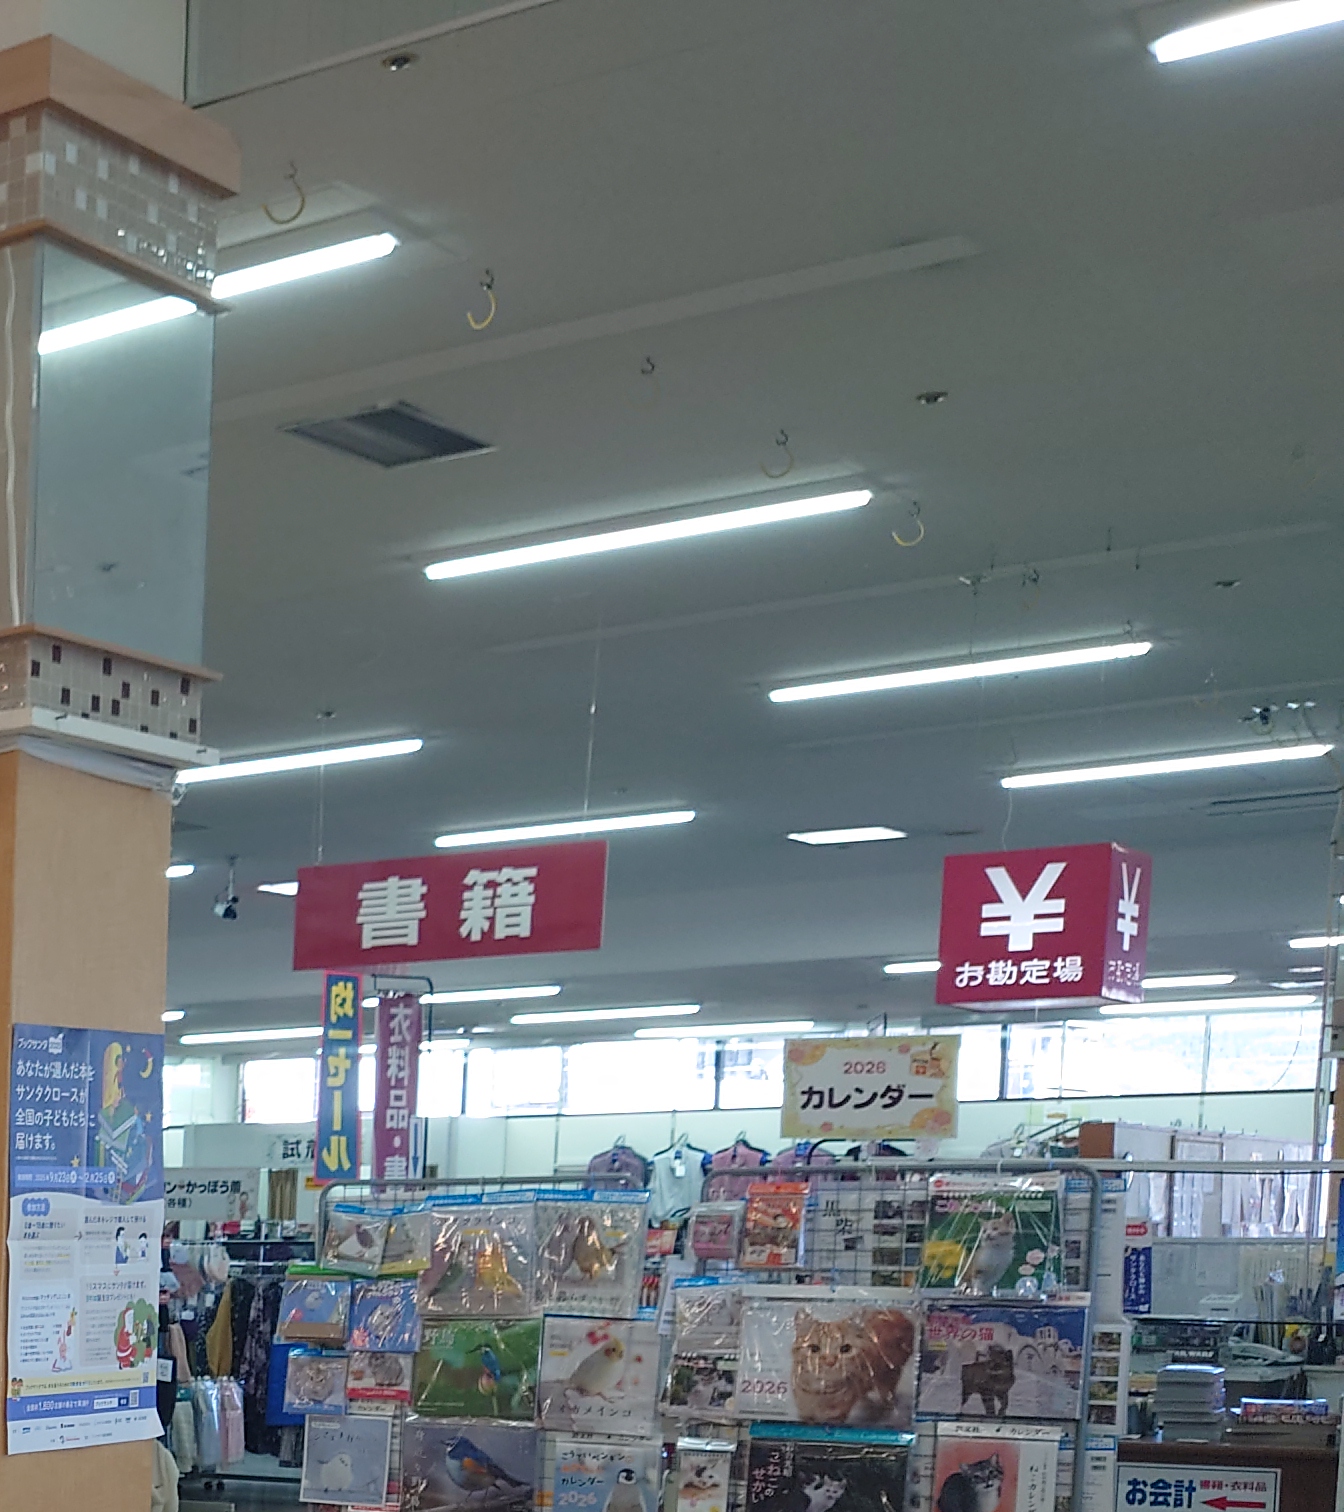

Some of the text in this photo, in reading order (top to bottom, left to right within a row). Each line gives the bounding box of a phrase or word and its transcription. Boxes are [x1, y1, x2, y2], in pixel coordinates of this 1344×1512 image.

[356, 866, 538, 949] 書籍
[980, 862, 1068, 952] ¥
[955, 955, 1084, 989] お勘定場
[17, 1038, 48, 1050] ブックサンタ
[16, 1060, 95, 1081] あなたが選んだ本を
[843, 1061, 886, 1075] 2026
[15, 1085, 87, 1103] サンタクロースが
[800, 1083, 934, 1110] カレンダー
[15, 1108, 96, 1126] 全国の子どもたちに
[15, 1132, 56, 1150] 届けます。
[927, 1325, 994, 1342] 世界の猫
[741, 1379, 788, 1395] 2026
[1125, 1477, 1197, 1508] お会計
[1200, 1480, 1267, 1492] 書籍・衣料品
[558, 1491, 597, 1508] 2026
